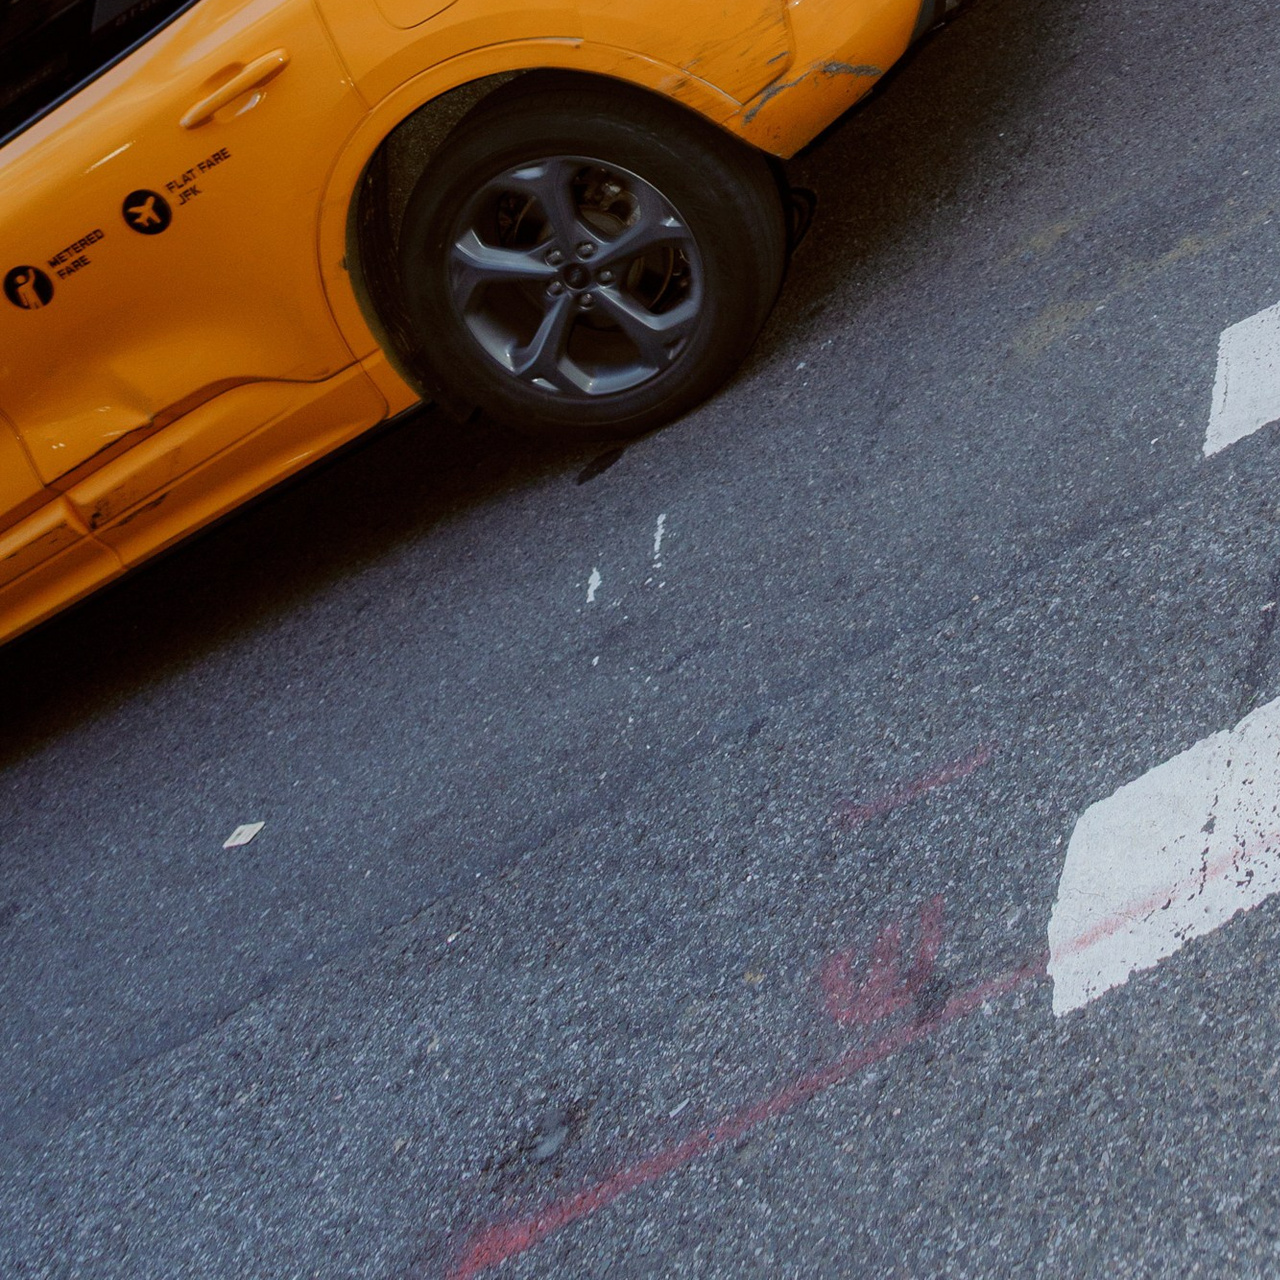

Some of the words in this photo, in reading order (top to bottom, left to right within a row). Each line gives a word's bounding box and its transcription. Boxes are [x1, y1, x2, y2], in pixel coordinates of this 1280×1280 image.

[165, 168, 197, 193] FLAT
[197, 147, 232, 174] FARE
[178, 185, 202, 206] JFK
[47, 228, 106, 269] METERED
[57, 255, 92, 280] FARE
